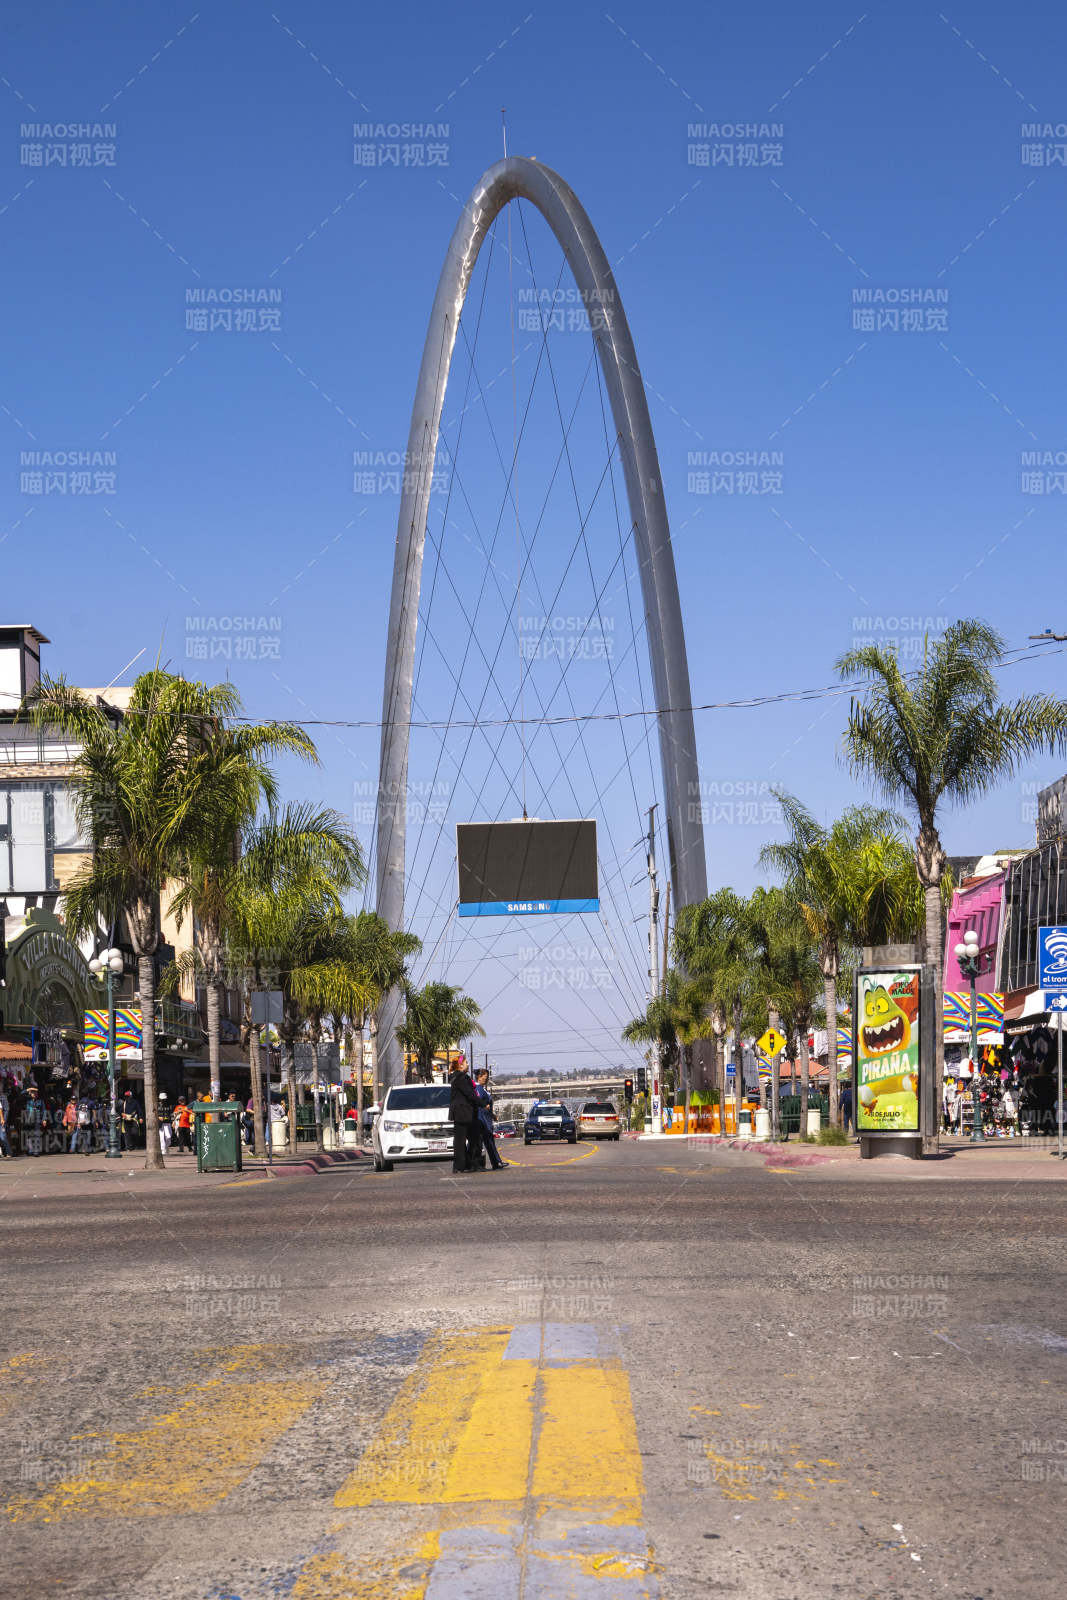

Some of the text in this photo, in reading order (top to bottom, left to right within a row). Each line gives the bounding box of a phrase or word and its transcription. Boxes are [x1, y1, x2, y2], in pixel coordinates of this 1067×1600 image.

[507, 903, 551, 912] SAMSUNG
[22, 931, 49, 970] VILLA
[861, 1051, 911, 1084] PIRAÑA
